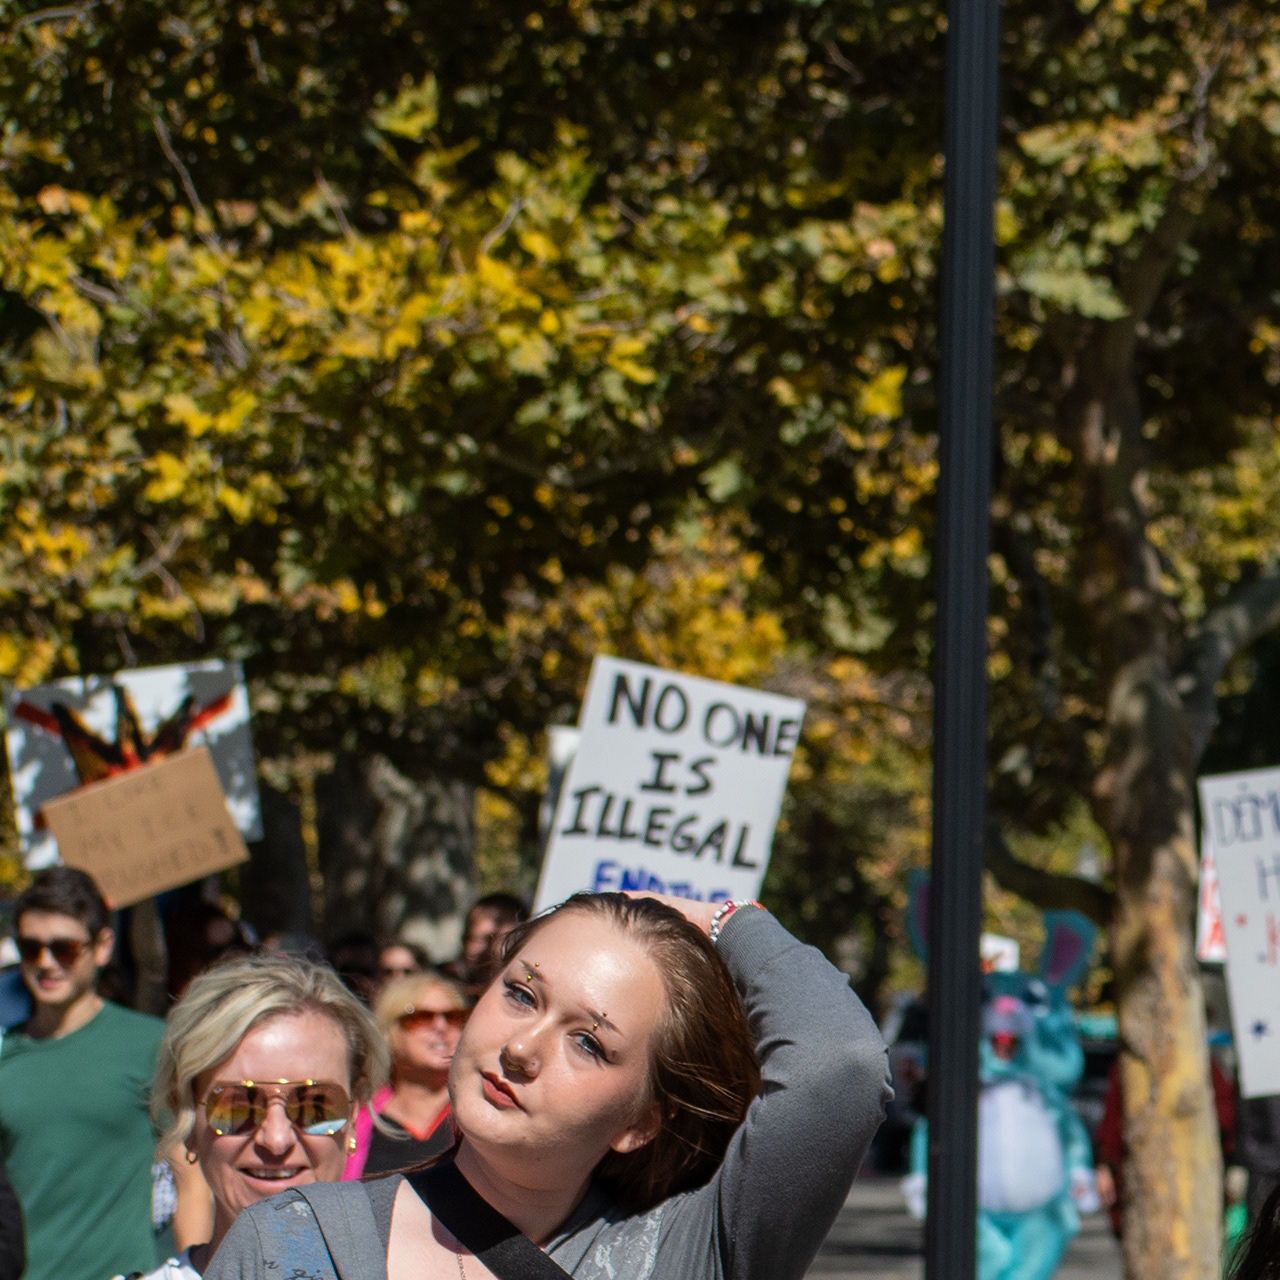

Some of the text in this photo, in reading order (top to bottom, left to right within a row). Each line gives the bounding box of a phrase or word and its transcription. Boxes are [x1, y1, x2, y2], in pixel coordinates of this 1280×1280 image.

[607, 672, 800, 758] NO ONE
[640, 750, 718, 796] IS
[561, 784, 758, 870] ILLEGAL
